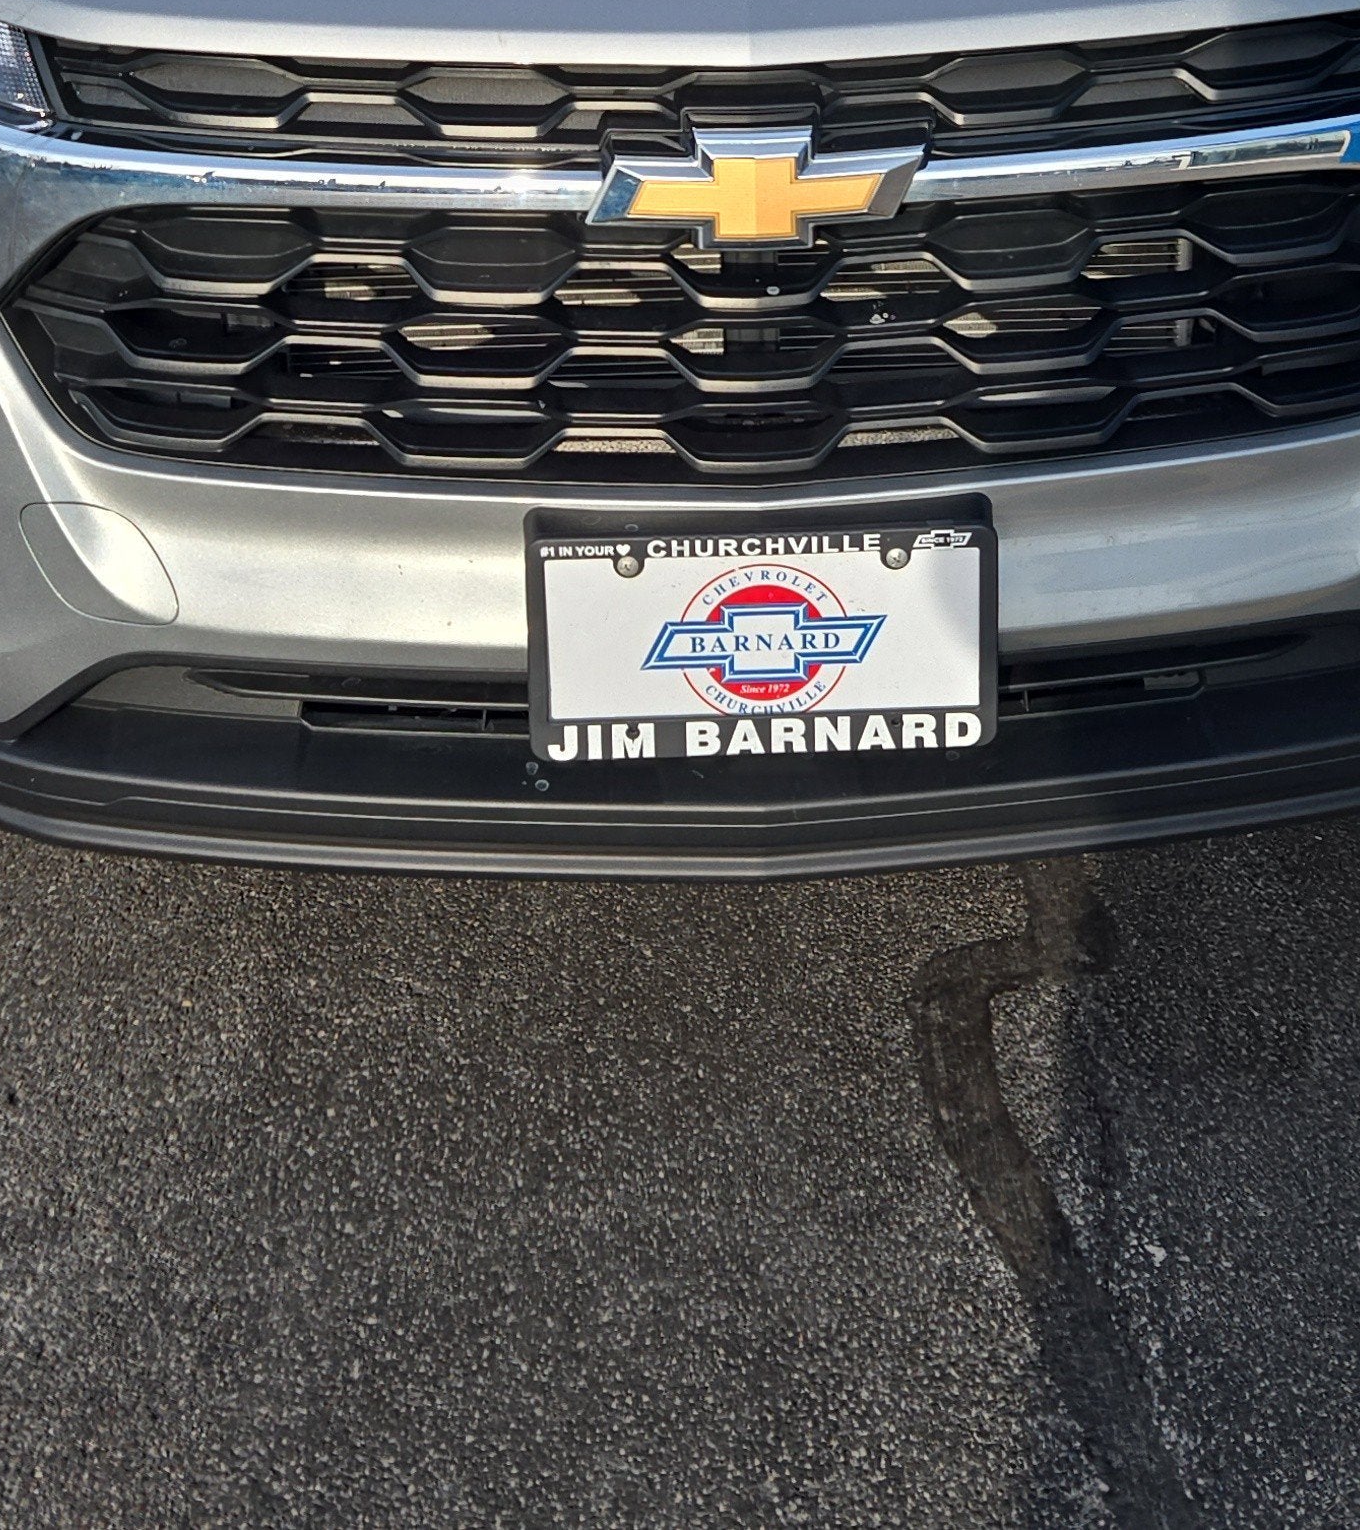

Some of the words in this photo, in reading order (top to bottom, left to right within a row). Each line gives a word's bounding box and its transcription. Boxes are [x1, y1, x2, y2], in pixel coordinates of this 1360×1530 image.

[558, 546, 573, 557] IN
[575, 545, 615, 557] YOUR
[646, 533, 882, 558] CHURCHVILLE
[702, 569, 828, 606] CHEVROLET
[690, 632, 841, 654] BARNARD
[704, 680, 827, 715] CHURCHVILLE
[740, 684, 766, 694] Since
[767, 683, 790, 694] 1972
[547, 722, 656, 762] JIM
[685, 712, 982, 758] BARNARD
